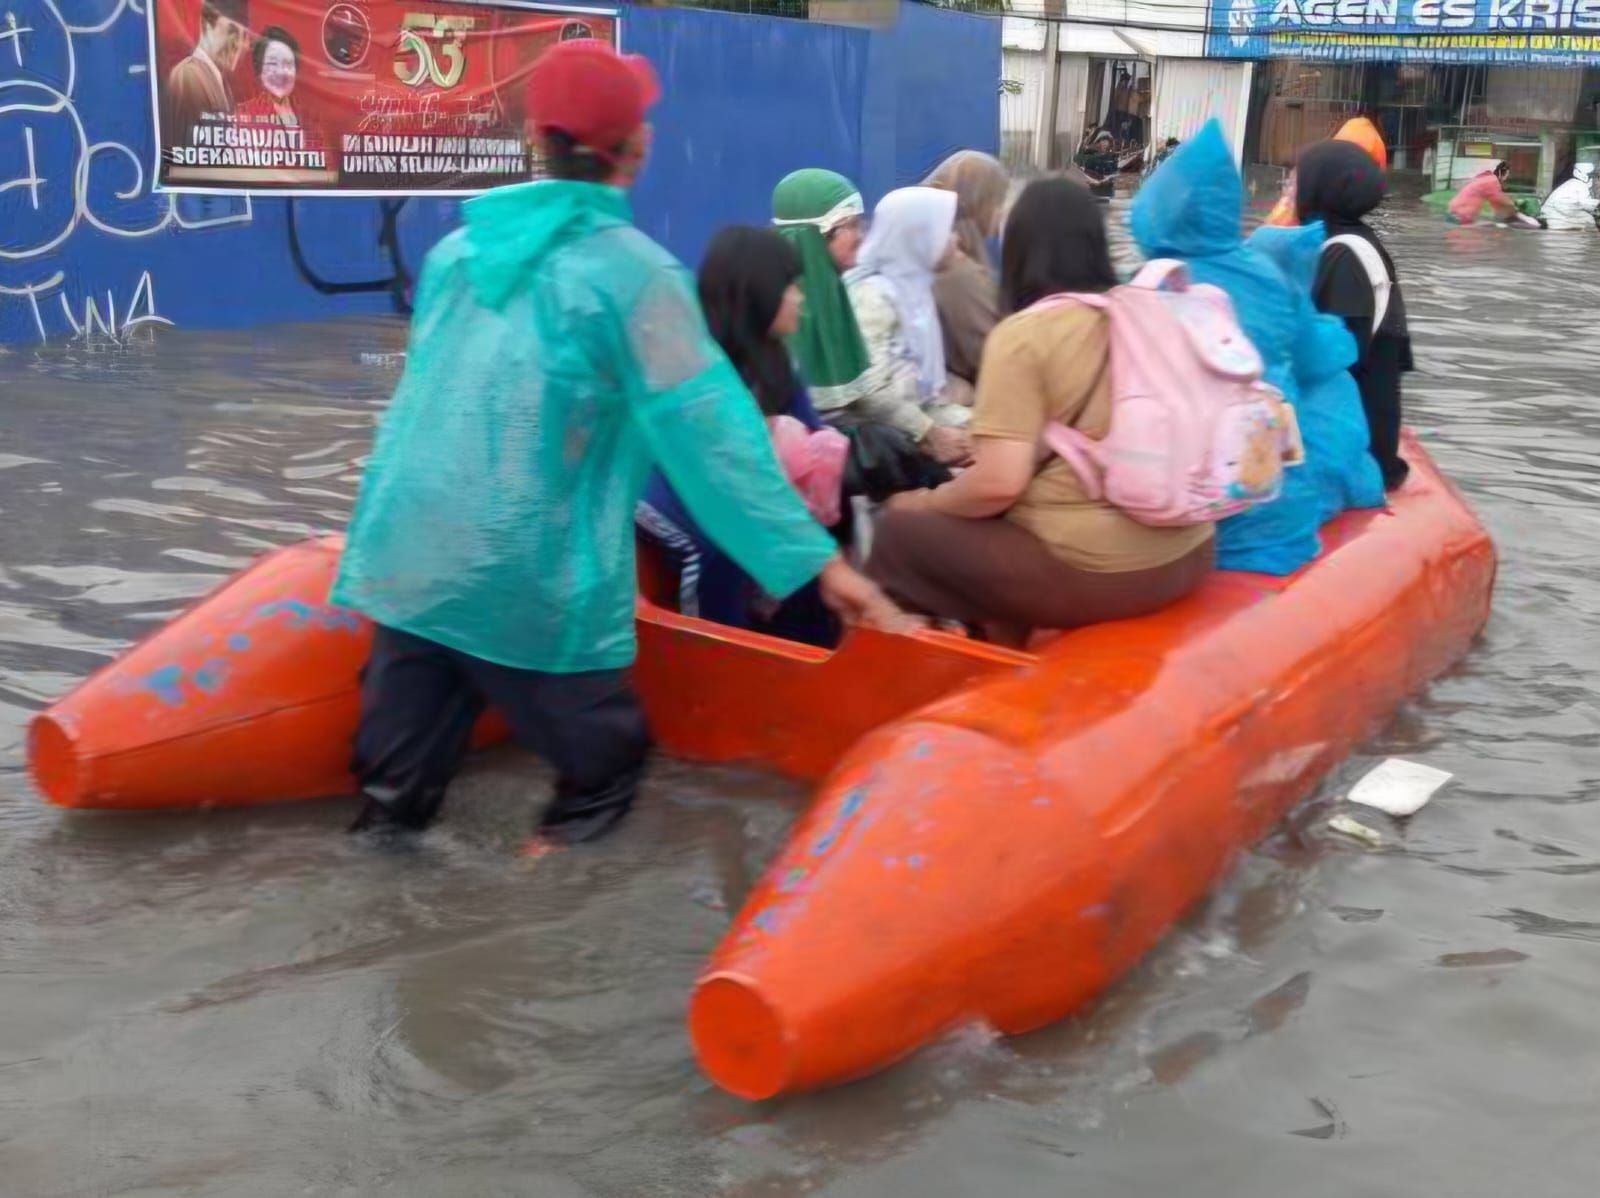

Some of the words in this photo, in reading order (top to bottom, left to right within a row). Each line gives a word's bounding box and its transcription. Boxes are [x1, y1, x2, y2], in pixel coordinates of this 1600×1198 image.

[1269, 0, 1397, 25] AGEN
[1412, 0, 1477, 28] ES
[192, 125, 304, 150] MEGAWATI
[171, 146, 326, 168] SOEKARNOPUTRI
